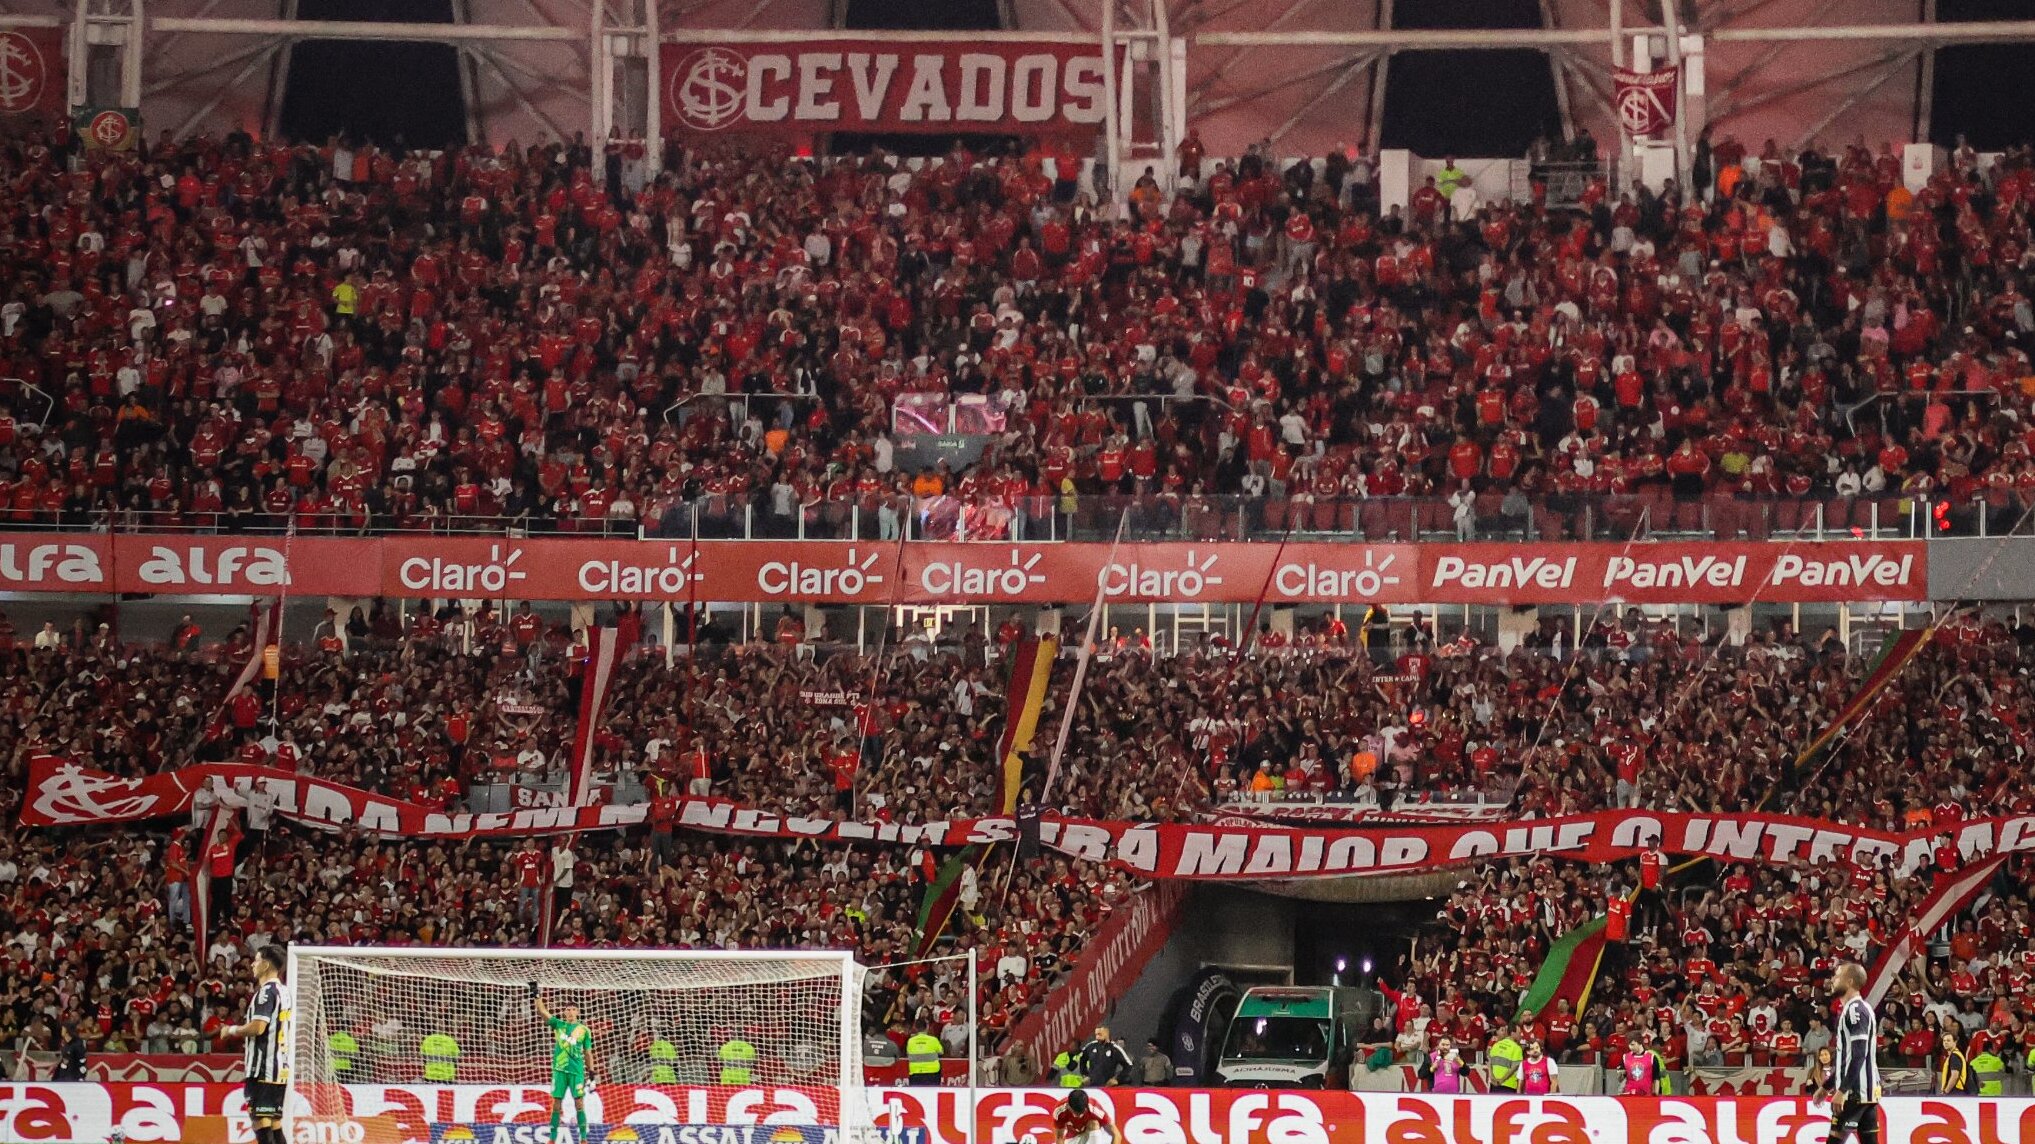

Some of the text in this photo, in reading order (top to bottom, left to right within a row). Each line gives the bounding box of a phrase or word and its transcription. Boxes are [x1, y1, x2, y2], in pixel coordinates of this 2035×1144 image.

[745, 52, 1107, 123] CEVADOS
[0, 543, 104, 582] lfa
[138, 546, 292, 585] alfa
[400, 554, 508, 591] Claro
[578, 556, 687, 593] Claro
[757, 558, 866, 595] Claro
[921, 558, 1030, 595] Claro
[1098, 558, 1206, 597] Claro
[1276, 559, 1384, 597] Claro
[1432, 555, 1577, 589] PanVel
[1603, 554, 1747, 589] PanVel
[1771, 554, 1913, 588] PanVel
[518, 787, 602, 808] SANA
[492, 1126, 576, 1144] ASSA
[1123, 1092, 1317, 1144] alfa
[1387, 1097, 1589, 1144] alfa
